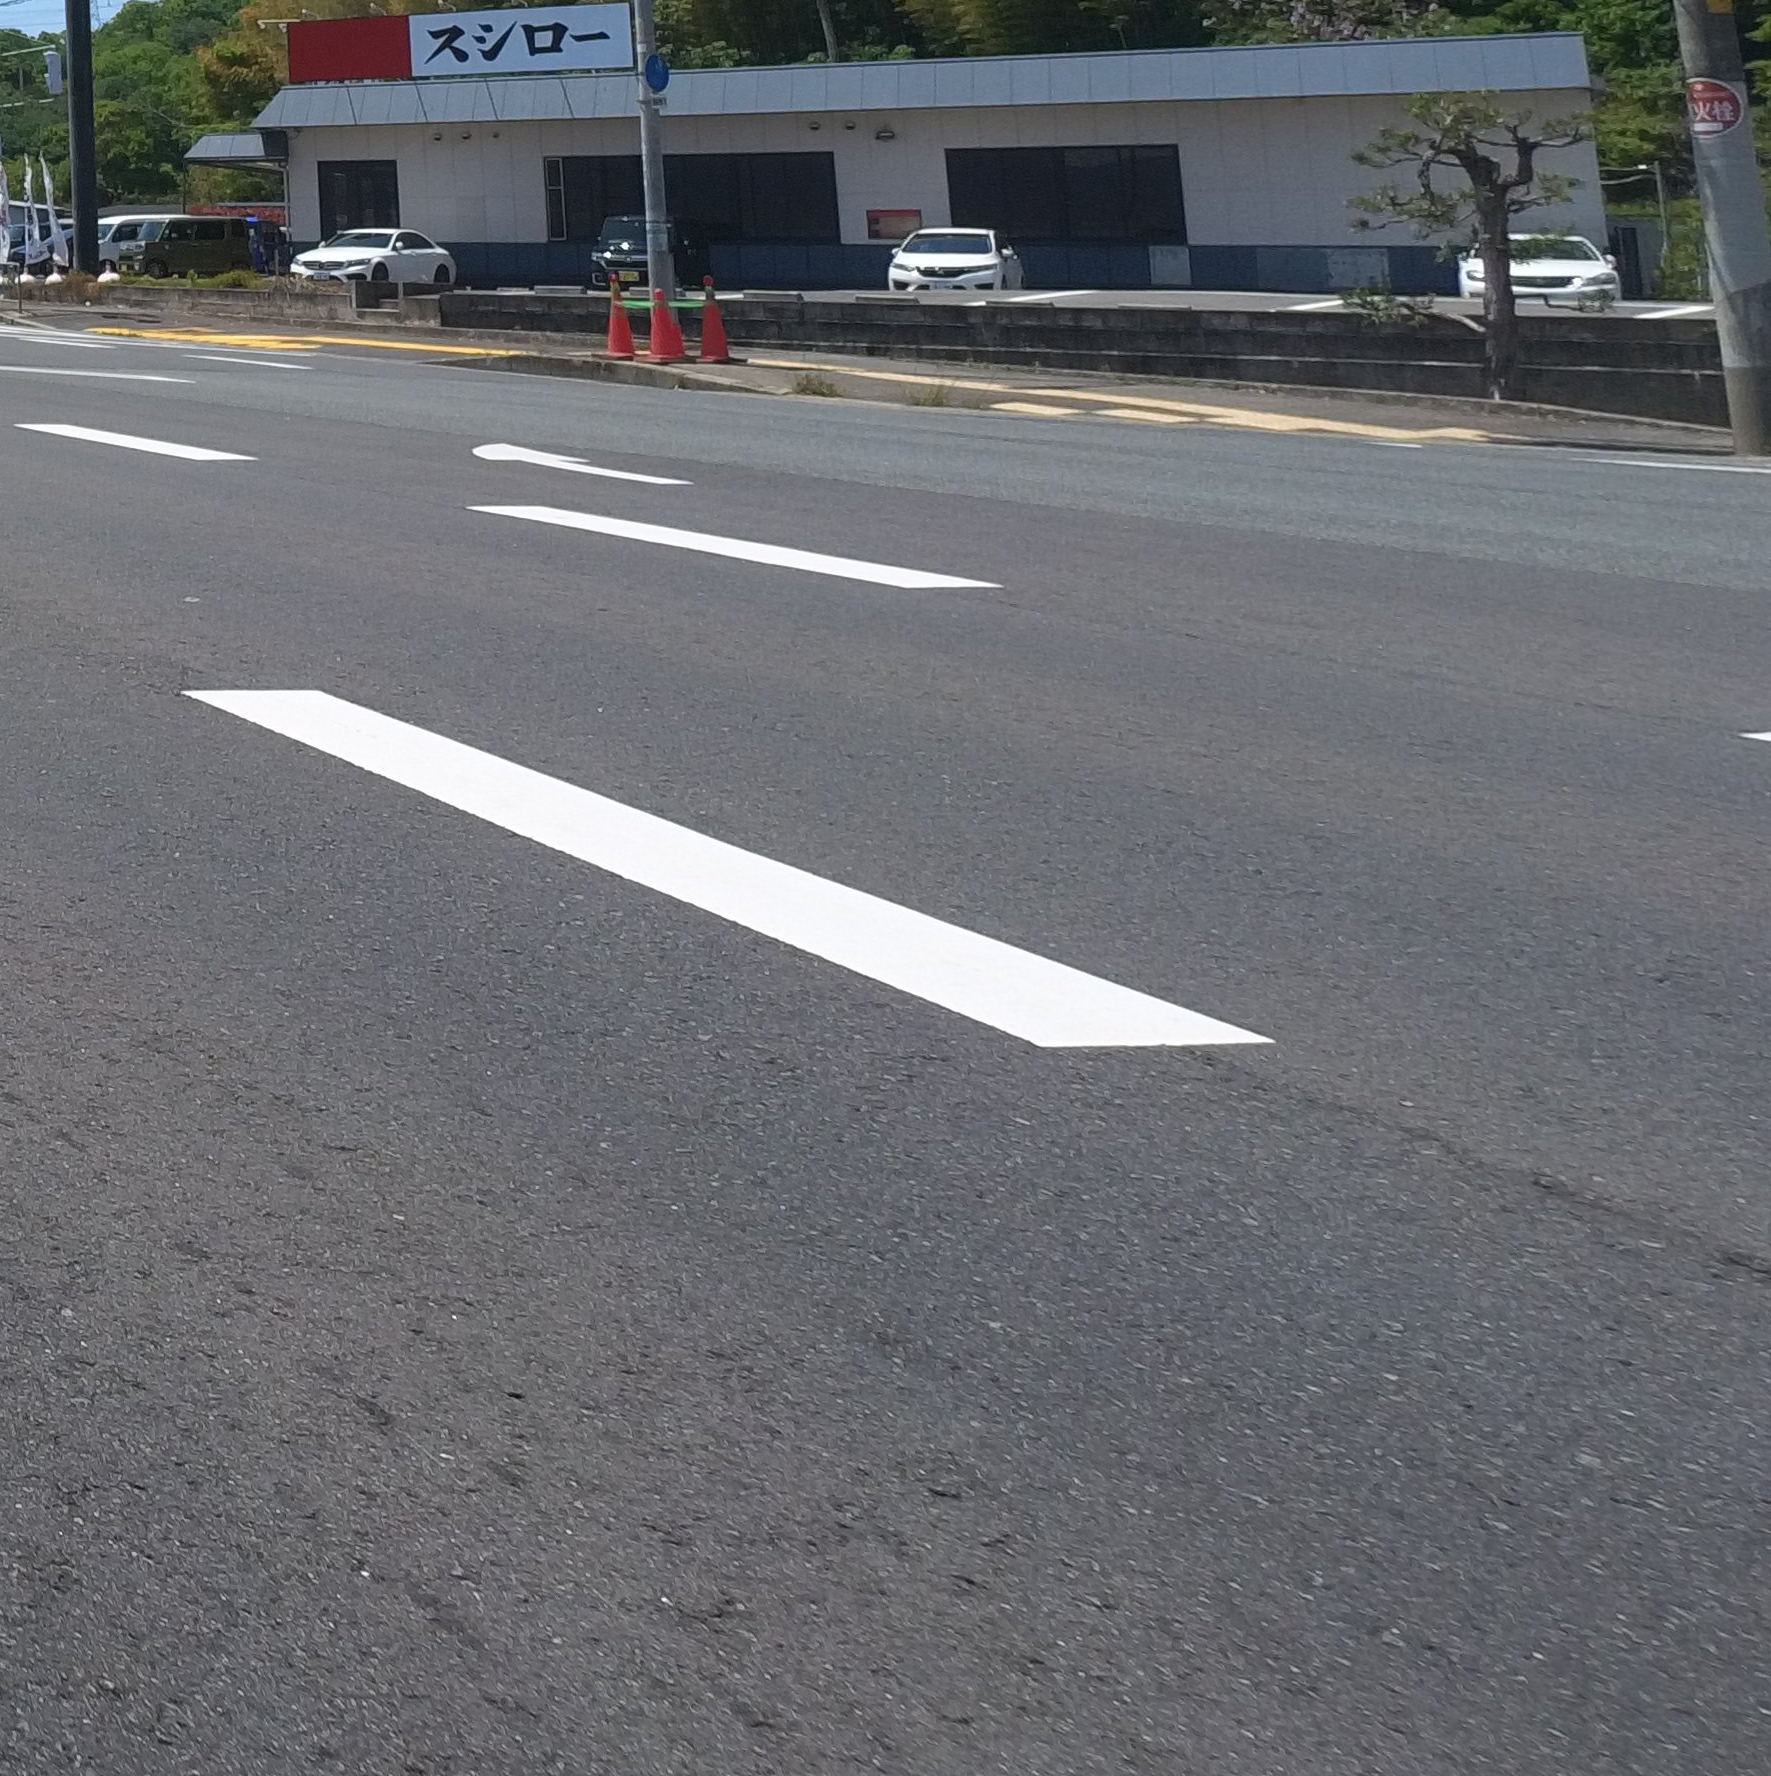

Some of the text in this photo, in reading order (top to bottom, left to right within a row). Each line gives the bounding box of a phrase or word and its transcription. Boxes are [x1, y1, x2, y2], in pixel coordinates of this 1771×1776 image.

[424, 21, 611, 65] スシロー
[1692, 100, 1736, 121] 火栓
